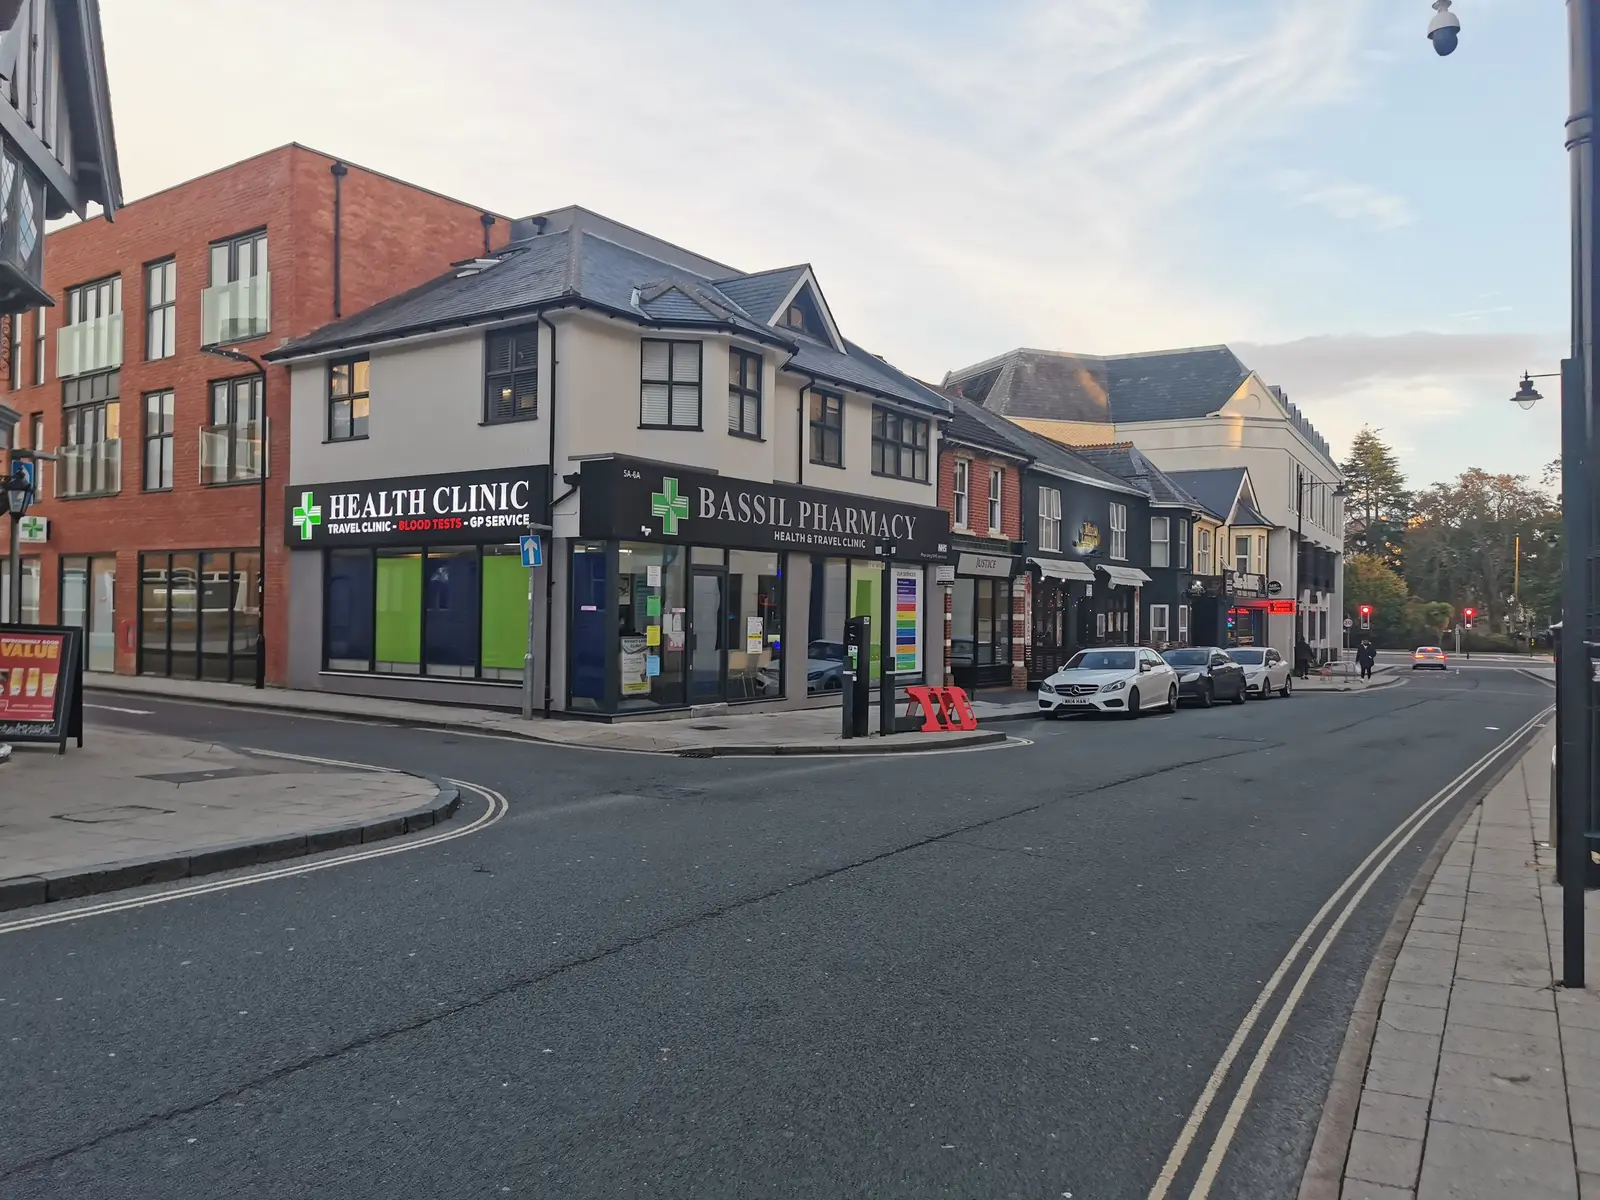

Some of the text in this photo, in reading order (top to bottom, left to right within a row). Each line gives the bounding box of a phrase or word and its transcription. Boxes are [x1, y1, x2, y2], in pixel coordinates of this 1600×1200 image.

[623, 469, 641, 479] 5A-6A
[329, 480, 529, 520] HEALTH CLINIC
[697, 486, 917, 540] BASSIL PHARMACY
[328, 522, 361, 534] TRAVEL
[362, 521, 391, 533] CLINIC
[398, 519, 431, 531] BLOOD
[432, 517, 462, 530] TESTS
[470, 516, 485, 528] GP
[485, 514, 530, 527] SERVICE
[774, 531, 866, 548] HEALTH & TRAVEL CLINIC
[1, 643, 58, 659] VALUE
